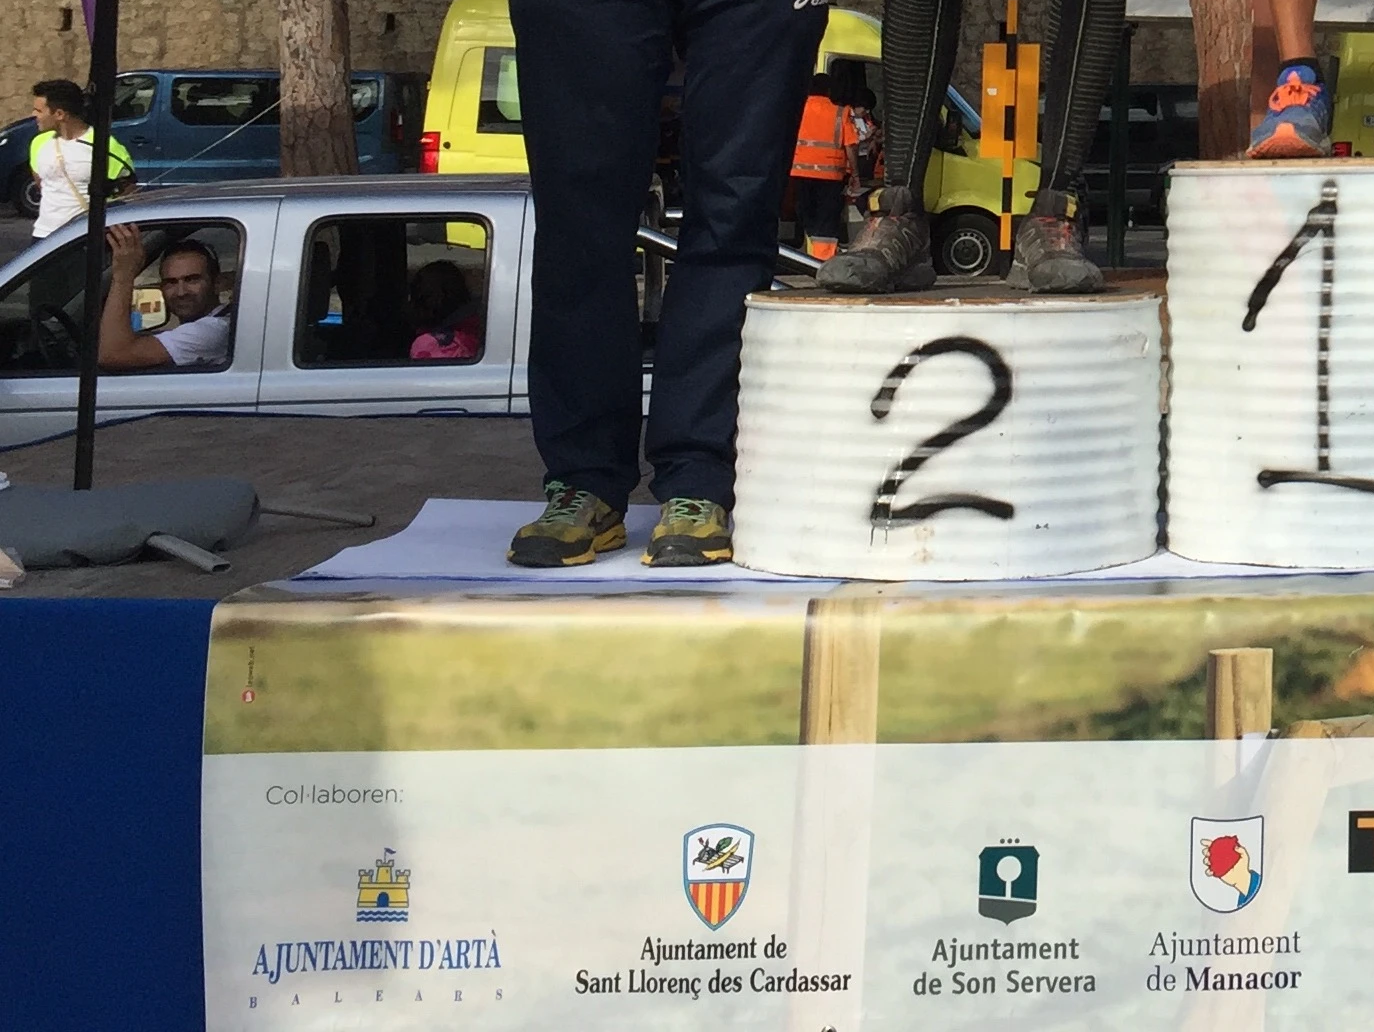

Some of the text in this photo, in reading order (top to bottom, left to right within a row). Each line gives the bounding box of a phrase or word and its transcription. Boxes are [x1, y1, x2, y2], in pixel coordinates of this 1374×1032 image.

[870, 335, 1015, 530] 2
[252, 929, 502, 985] AJUNTAMENT D'ARTÀ
[640, 934, 787, 966] Ajuntament de
[931, 937, 1080, 968] Ajuntament
[1148, 930, 1302, 963] Ajuntament
[575, 967, 852, 1000] Sant Llorenç des Cardassar
[913, 969, 1097, 996] de Son Servera
[1146, 964, 1303, 992] de Manacor
